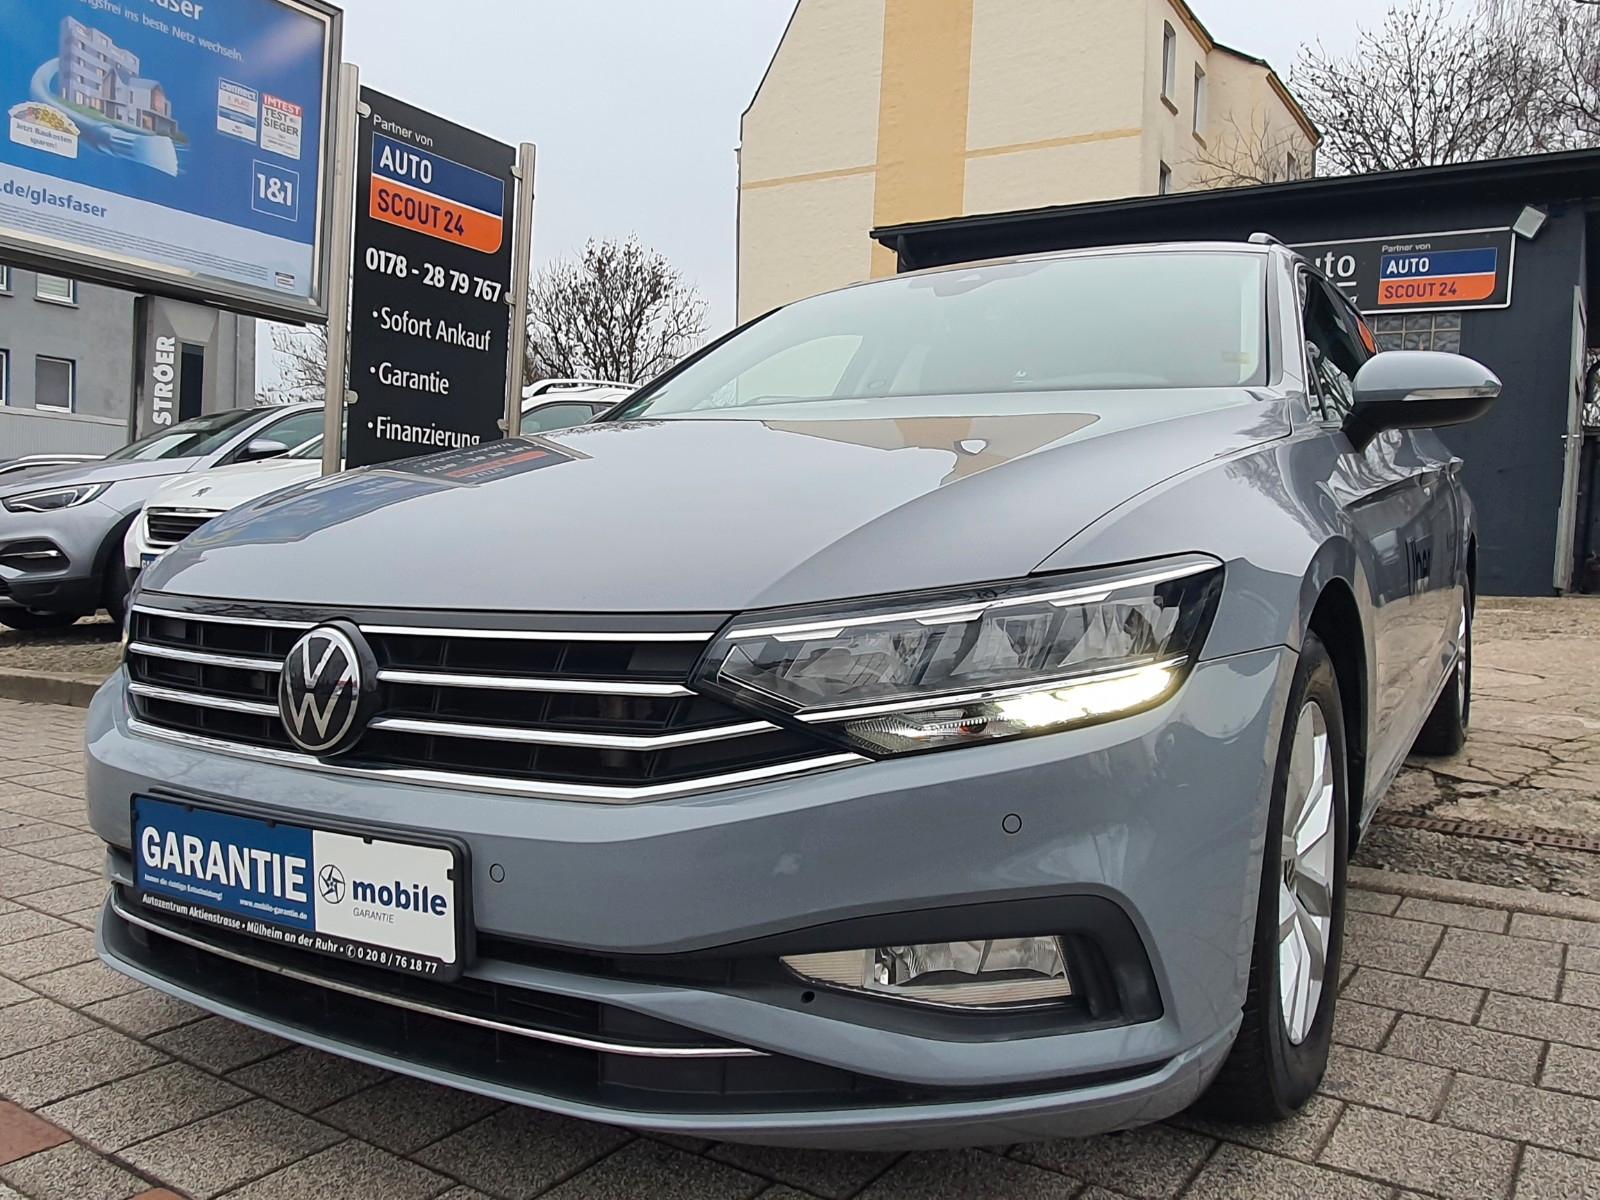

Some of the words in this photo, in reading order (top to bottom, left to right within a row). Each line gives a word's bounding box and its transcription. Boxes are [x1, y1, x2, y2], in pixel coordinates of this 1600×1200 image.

[124, 9, 140, 22] ins
[142, 12, 169, 34] beste
[172, 25, 195, 44] Netz
[263, 117, 299, 136] SIEGER
[265, 107, 288, 123] TEST
[373, 114, 413, 139] Partner
[414, 132, 434, 147] von
[379, 144, 433, 184] AUTO
[256, 172, 293, 207] 1&1
[1381, 243, 1414, 253] Partner
[1415, 242, 1431, 250] von
[365, 247, 408, 278] 0178
[422, 262, 445, 288] 28
[449, 269, 470, 295] 79
[473, 276, 502, 303] 767
[1386, 257, 1430, 275] AUTO
[380, 306, 432, 339] Sofort
[435, 320, 492, 351] Ankauf
[152, 336, 176, 426] STRÖER
[378, 362, 450, 395] Garantie
[141, 826, 308, 903] GARANTIE
[352, 880, 448, 916] mobile
[353, 907, 395, 924] GARANTIE
[142, 893, 188, 915] Autozentrum
[189, 906, 241, 930] Aktienstrasse
[246, 920, 283, 940] Mülheim
[284, 932, 296, 943] an
[299, 933, 313, 947] der
[315, 937, 339, 953] Ruhr
[395, 955, 407, 969] 76
[409, 958, 422, 972] 18
[425, 961, 438, 974] 77
